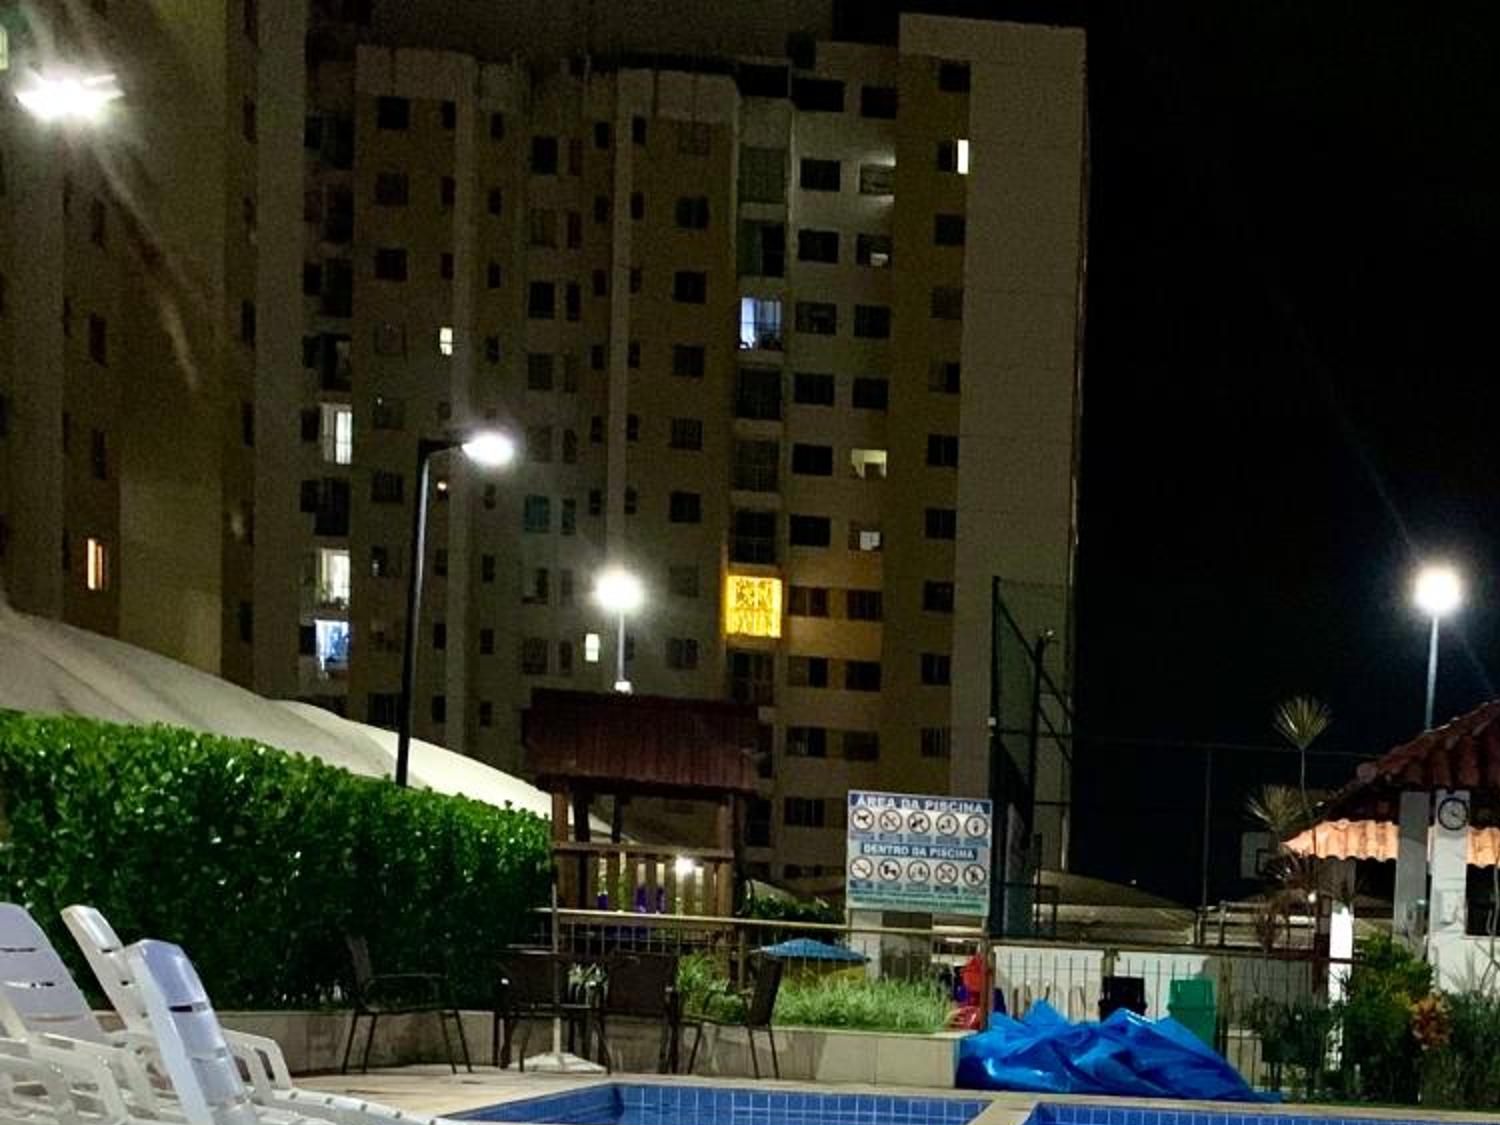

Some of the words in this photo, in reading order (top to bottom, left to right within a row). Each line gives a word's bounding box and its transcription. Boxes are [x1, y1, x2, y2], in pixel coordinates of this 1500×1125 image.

[901, 799, 920, 810] DA
[925, 801, 983, 814] PISCINA
[863, 843, 909, 855] DENTRO
[911, 848, 927, 857] DA
[929, 849, 974, 859] PISCINA
